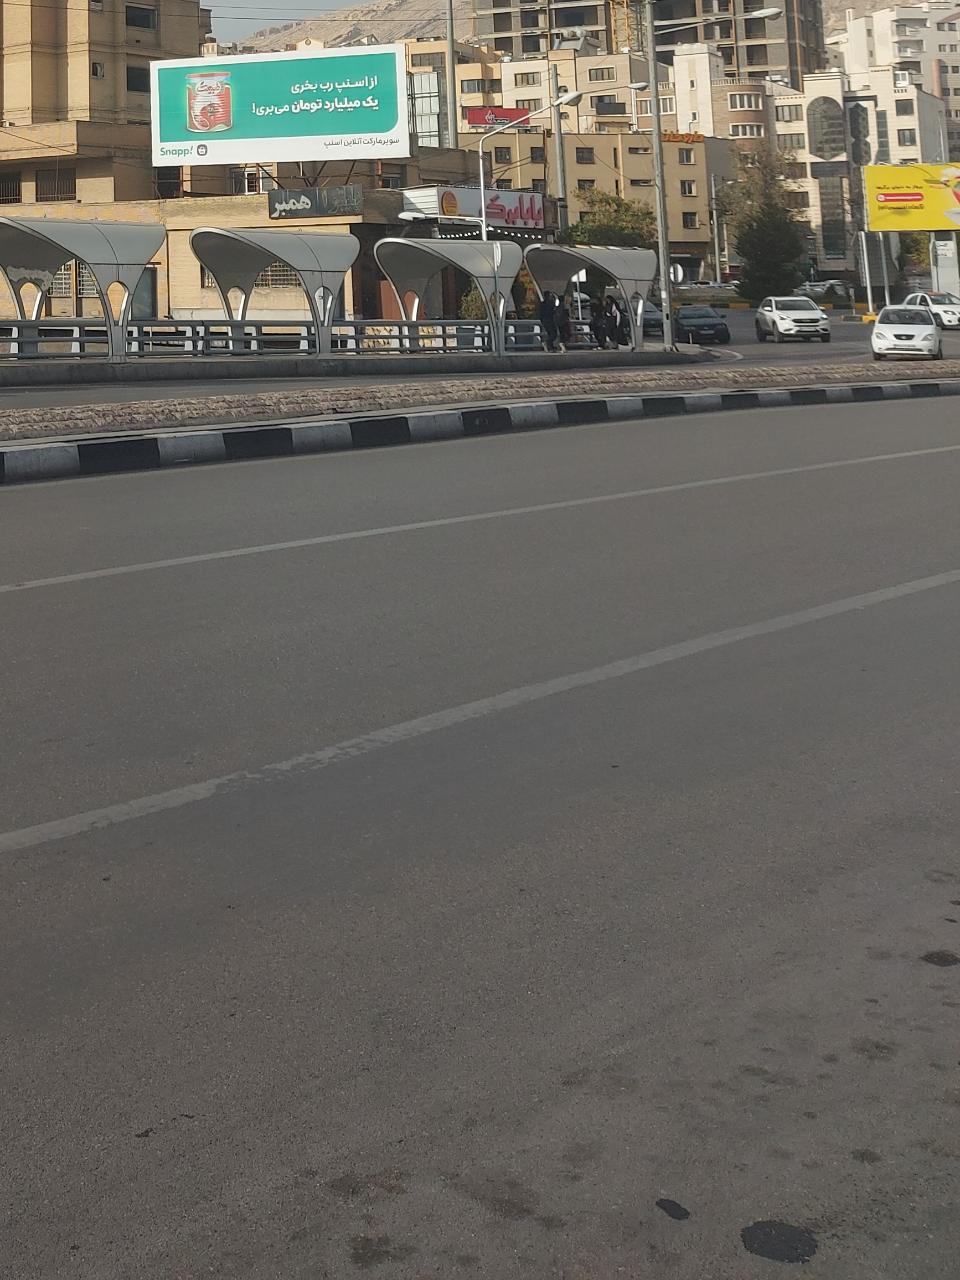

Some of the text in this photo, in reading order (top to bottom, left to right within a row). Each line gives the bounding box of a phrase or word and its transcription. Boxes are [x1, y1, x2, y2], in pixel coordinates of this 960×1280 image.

[291, 75, 378, 94] از اسنپ رب بخری
[291, 99, 322, 112] تومان
[324, 97, 360, 112] میلیارد
[362, 96, 379, 109] یک
[160, 145, 194, 157] Snapp!
